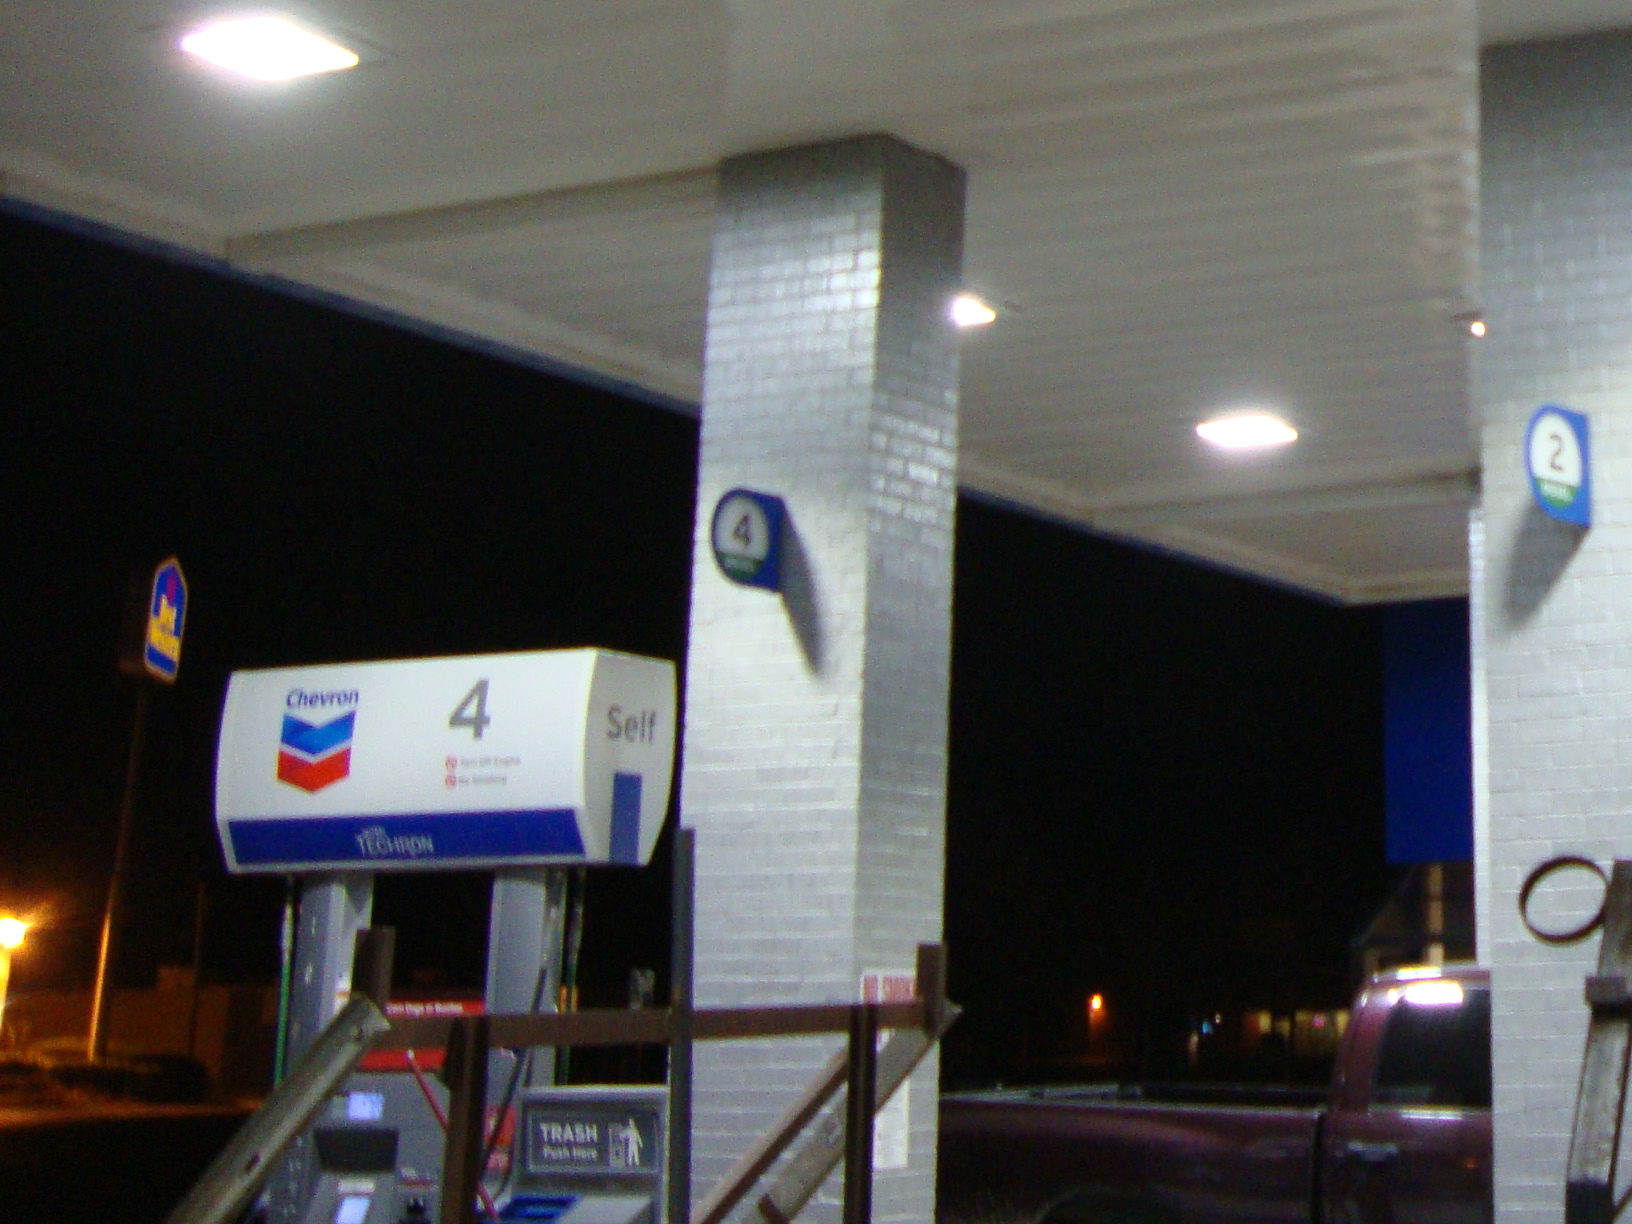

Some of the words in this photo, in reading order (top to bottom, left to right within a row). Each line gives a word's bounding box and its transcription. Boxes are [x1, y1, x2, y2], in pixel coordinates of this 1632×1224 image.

[1548, 432, 1565, 473] 2
[733, 514, 751, 549] 4
[286, 686, 360, 710] Chevron
[449, 678, 491, 741] 4
[606, 704, 658, 744] Self
[540, 1122, 598, 1143] TRASH
